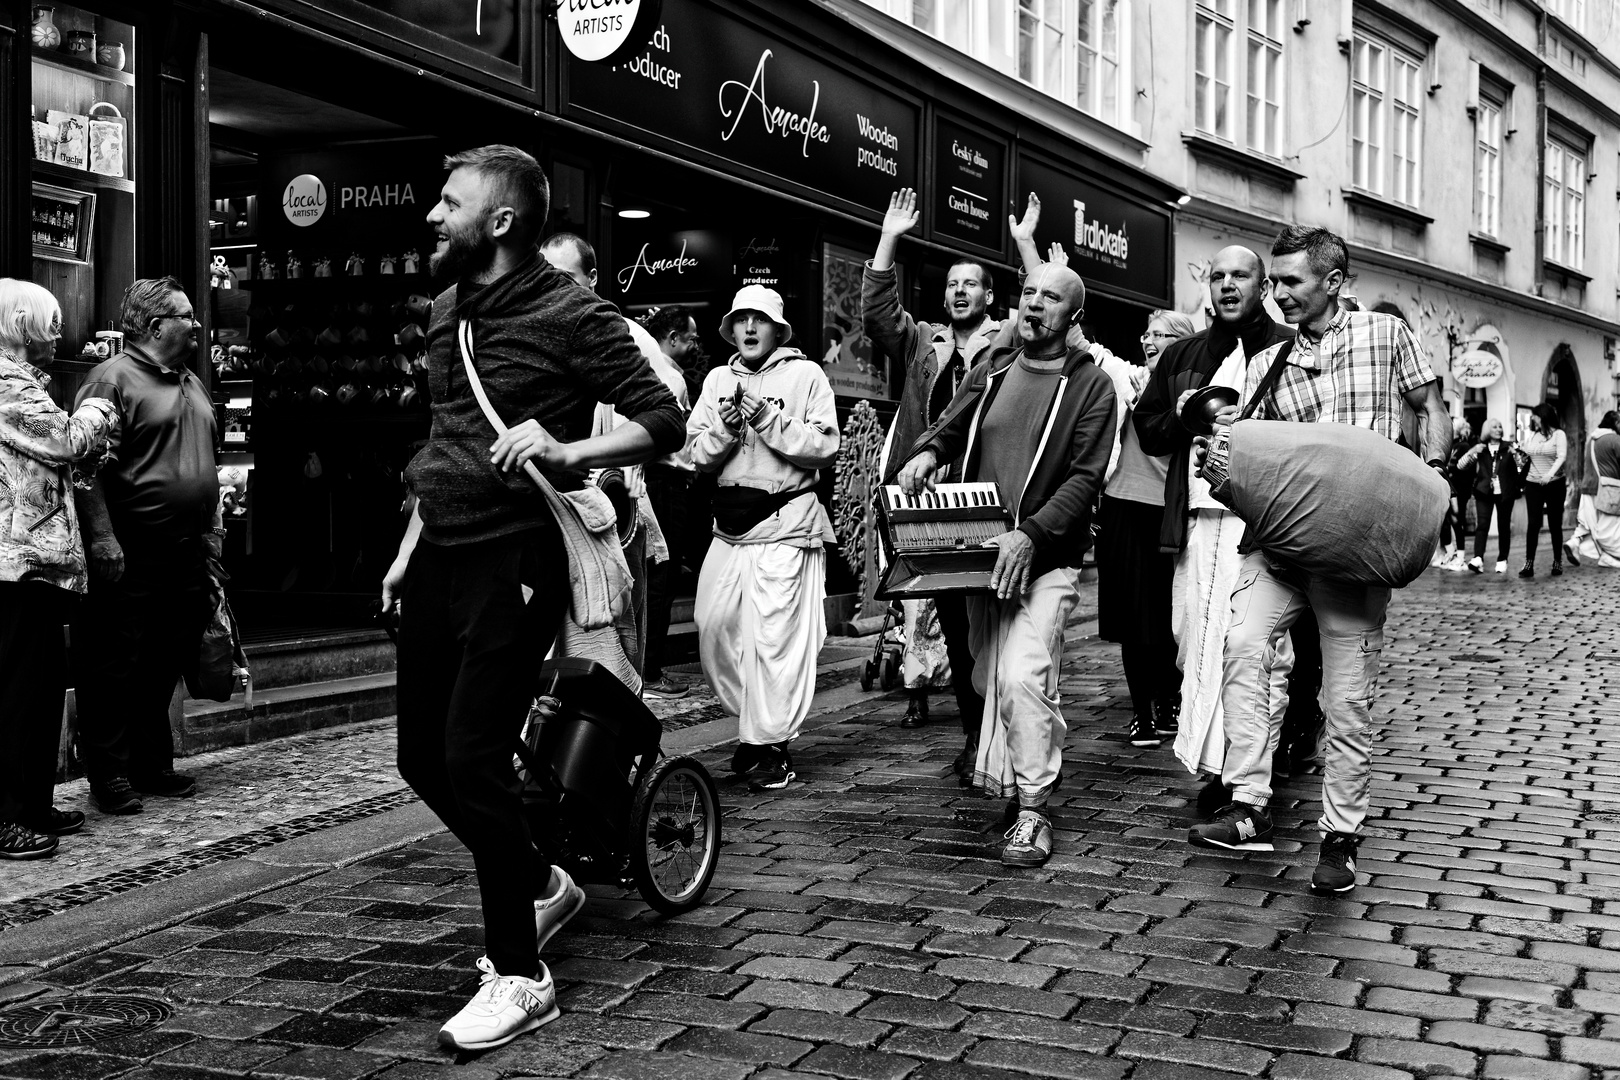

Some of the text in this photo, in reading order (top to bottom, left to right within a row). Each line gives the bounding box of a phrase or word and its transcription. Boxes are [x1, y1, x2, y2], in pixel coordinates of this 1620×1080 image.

[573, 14, 623, 36] ARTISTS
[612, 52, 681, 89] oducer
[719, 49, 831, 158] Amadea
[856, 114, 898, 151] Wooden
[857, 147, 898, 176] products
[283, 182, 416, 209] local PRAHA
[948, 194, 990, 220] Czech house
[292, 209, 319, 218] ARTISTS
[738, 237, 780, 259] Amadea
[618, 238, 699, 293] Amadea
[748, 266, 771, 274] Czech
[742, 276, 779, 286] producer
[1235, 817, 1257, 841] N
